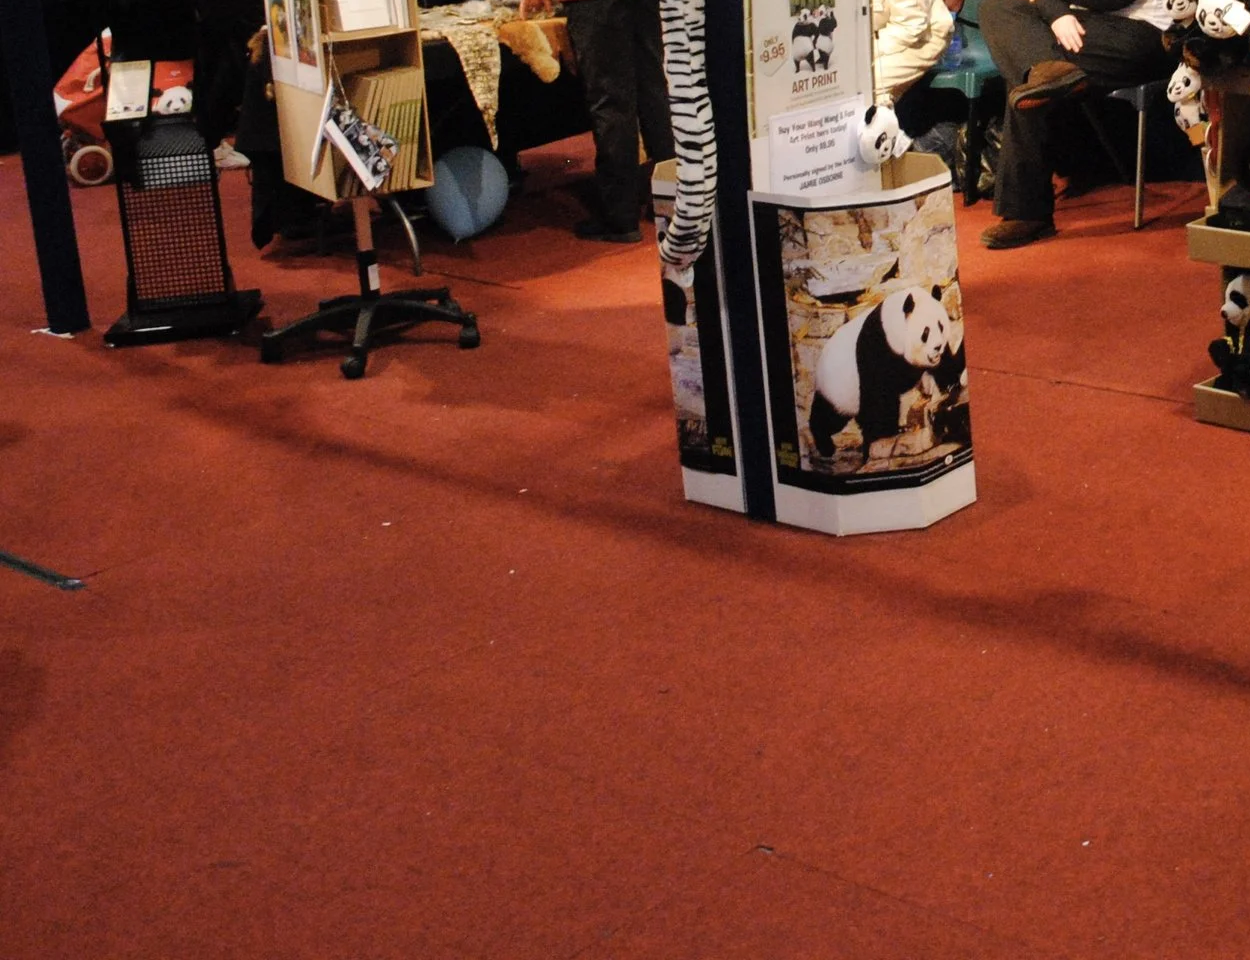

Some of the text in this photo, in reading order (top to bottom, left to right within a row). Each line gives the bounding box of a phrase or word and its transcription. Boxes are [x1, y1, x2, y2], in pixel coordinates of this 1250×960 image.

[759, 42, 786, 64] $9.95
[792, 70, 838, 95] ART PRINT
